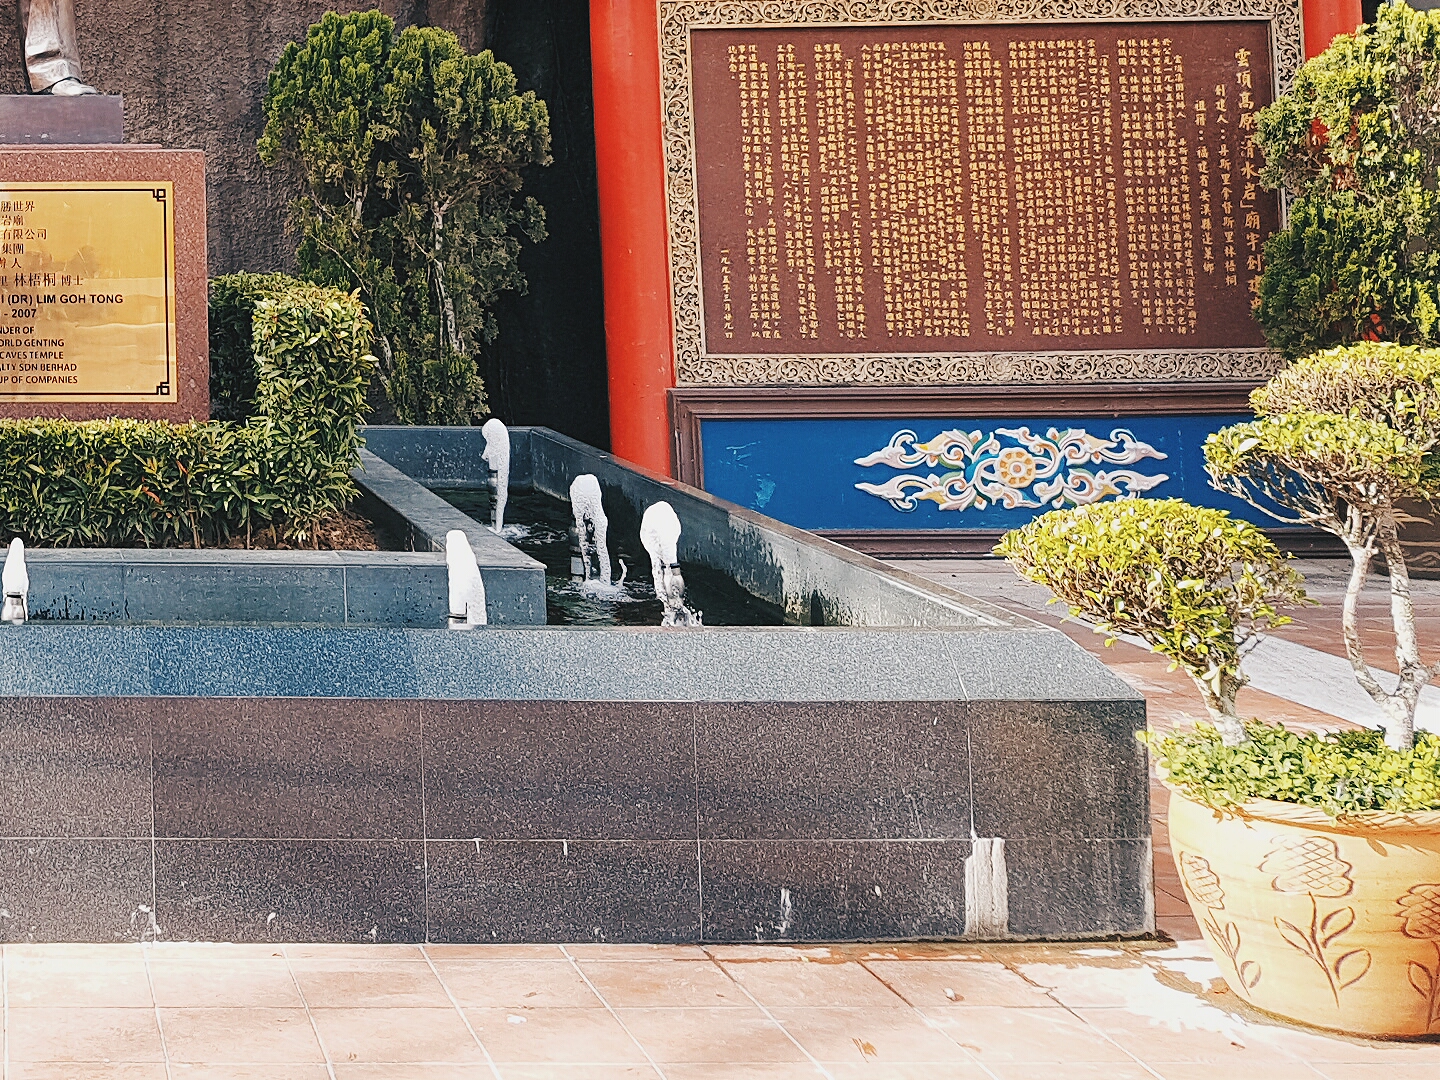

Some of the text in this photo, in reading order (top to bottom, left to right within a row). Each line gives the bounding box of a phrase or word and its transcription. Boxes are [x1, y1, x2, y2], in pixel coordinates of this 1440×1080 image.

[8, 294, 33, 306] (DR)
[37, 295, 56, 304] LIM
[60, 294, 86, 304] GOH
[90, 294, 123, 304] TONG
[11, 309, 36, 318] 2007
[24, 339, 64, 347] GENTING
[0, 351, 27, 359] CAVES
[30, 351, 64, 359] TEMPLE
[41, 363, 77, 371] BERHAD
[11, 376, 23, 384] OF
